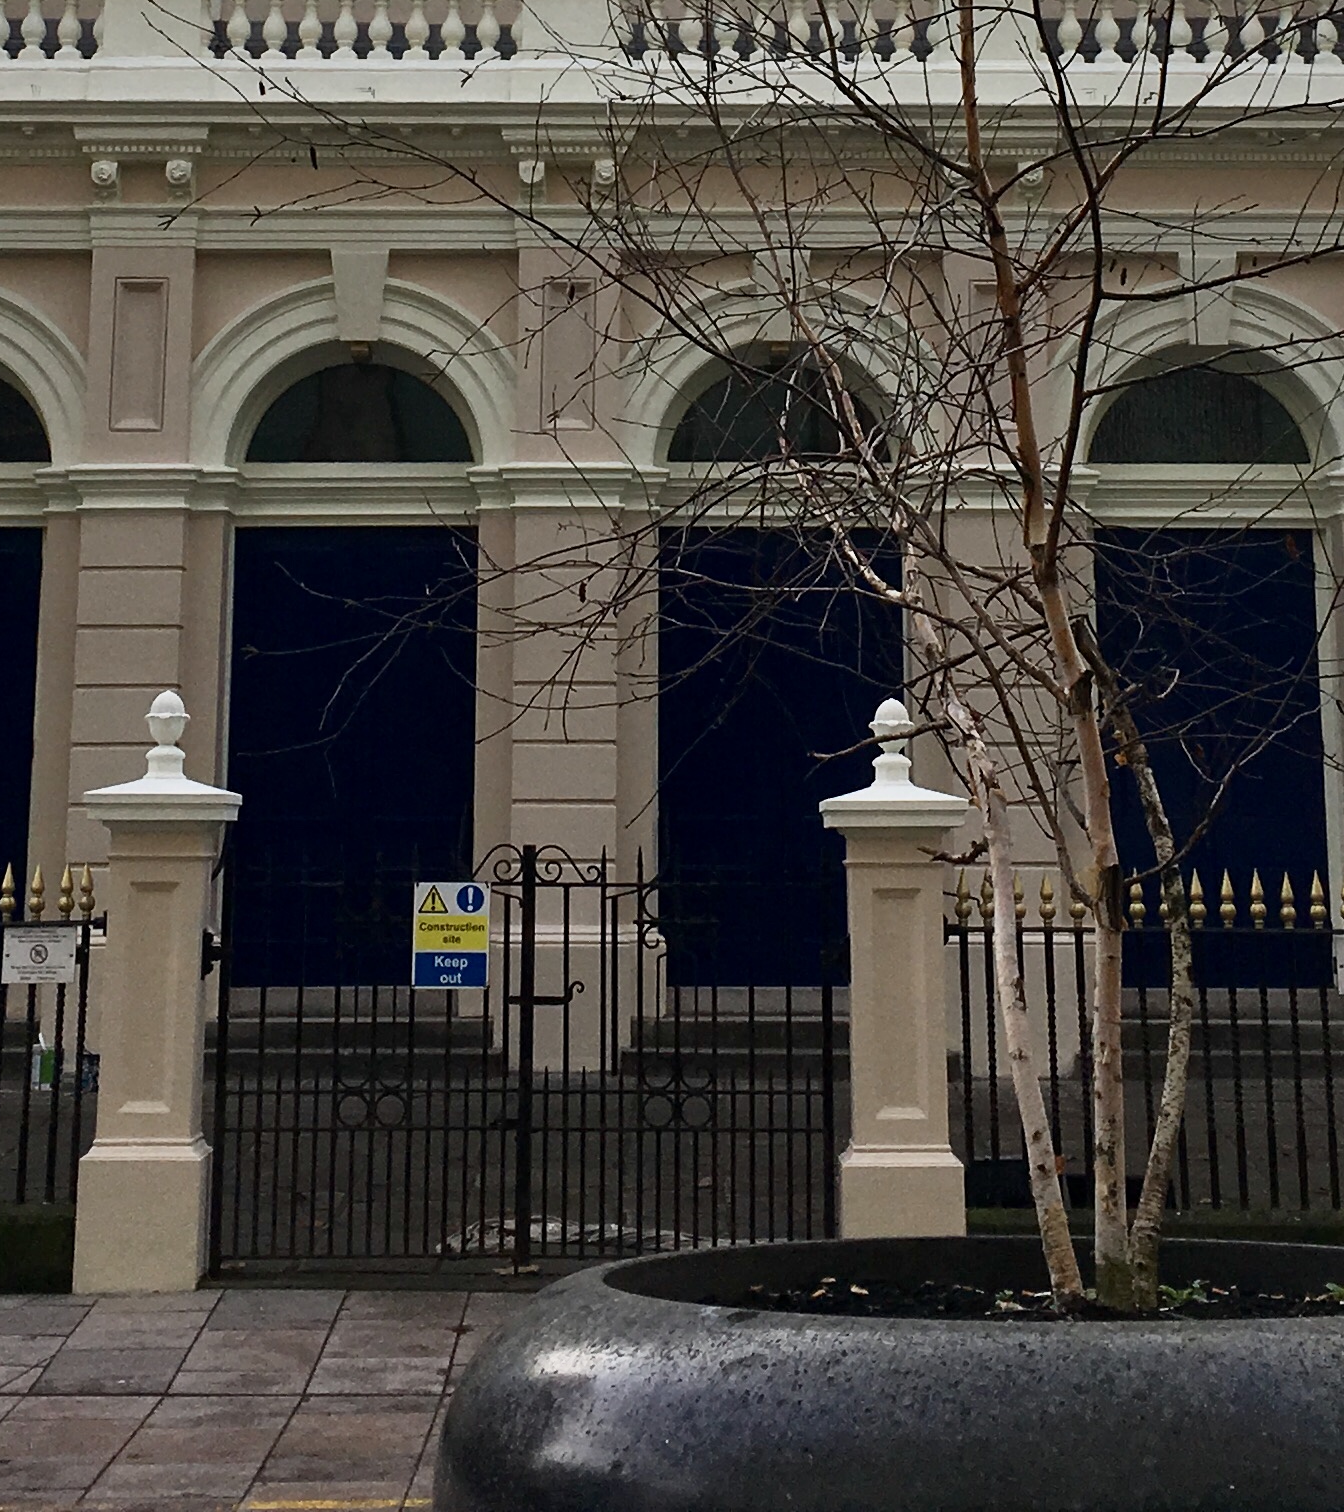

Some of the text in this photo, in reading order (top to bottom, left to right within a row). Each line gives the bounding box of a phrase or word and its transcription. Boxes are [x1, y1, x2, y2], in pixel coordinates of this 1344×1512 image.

[419, 922, 485, 932] Construction
[442, 935, 461, 943] site
[434, 955, 468, 970] Keep
[440, 973, 462, 983] out
